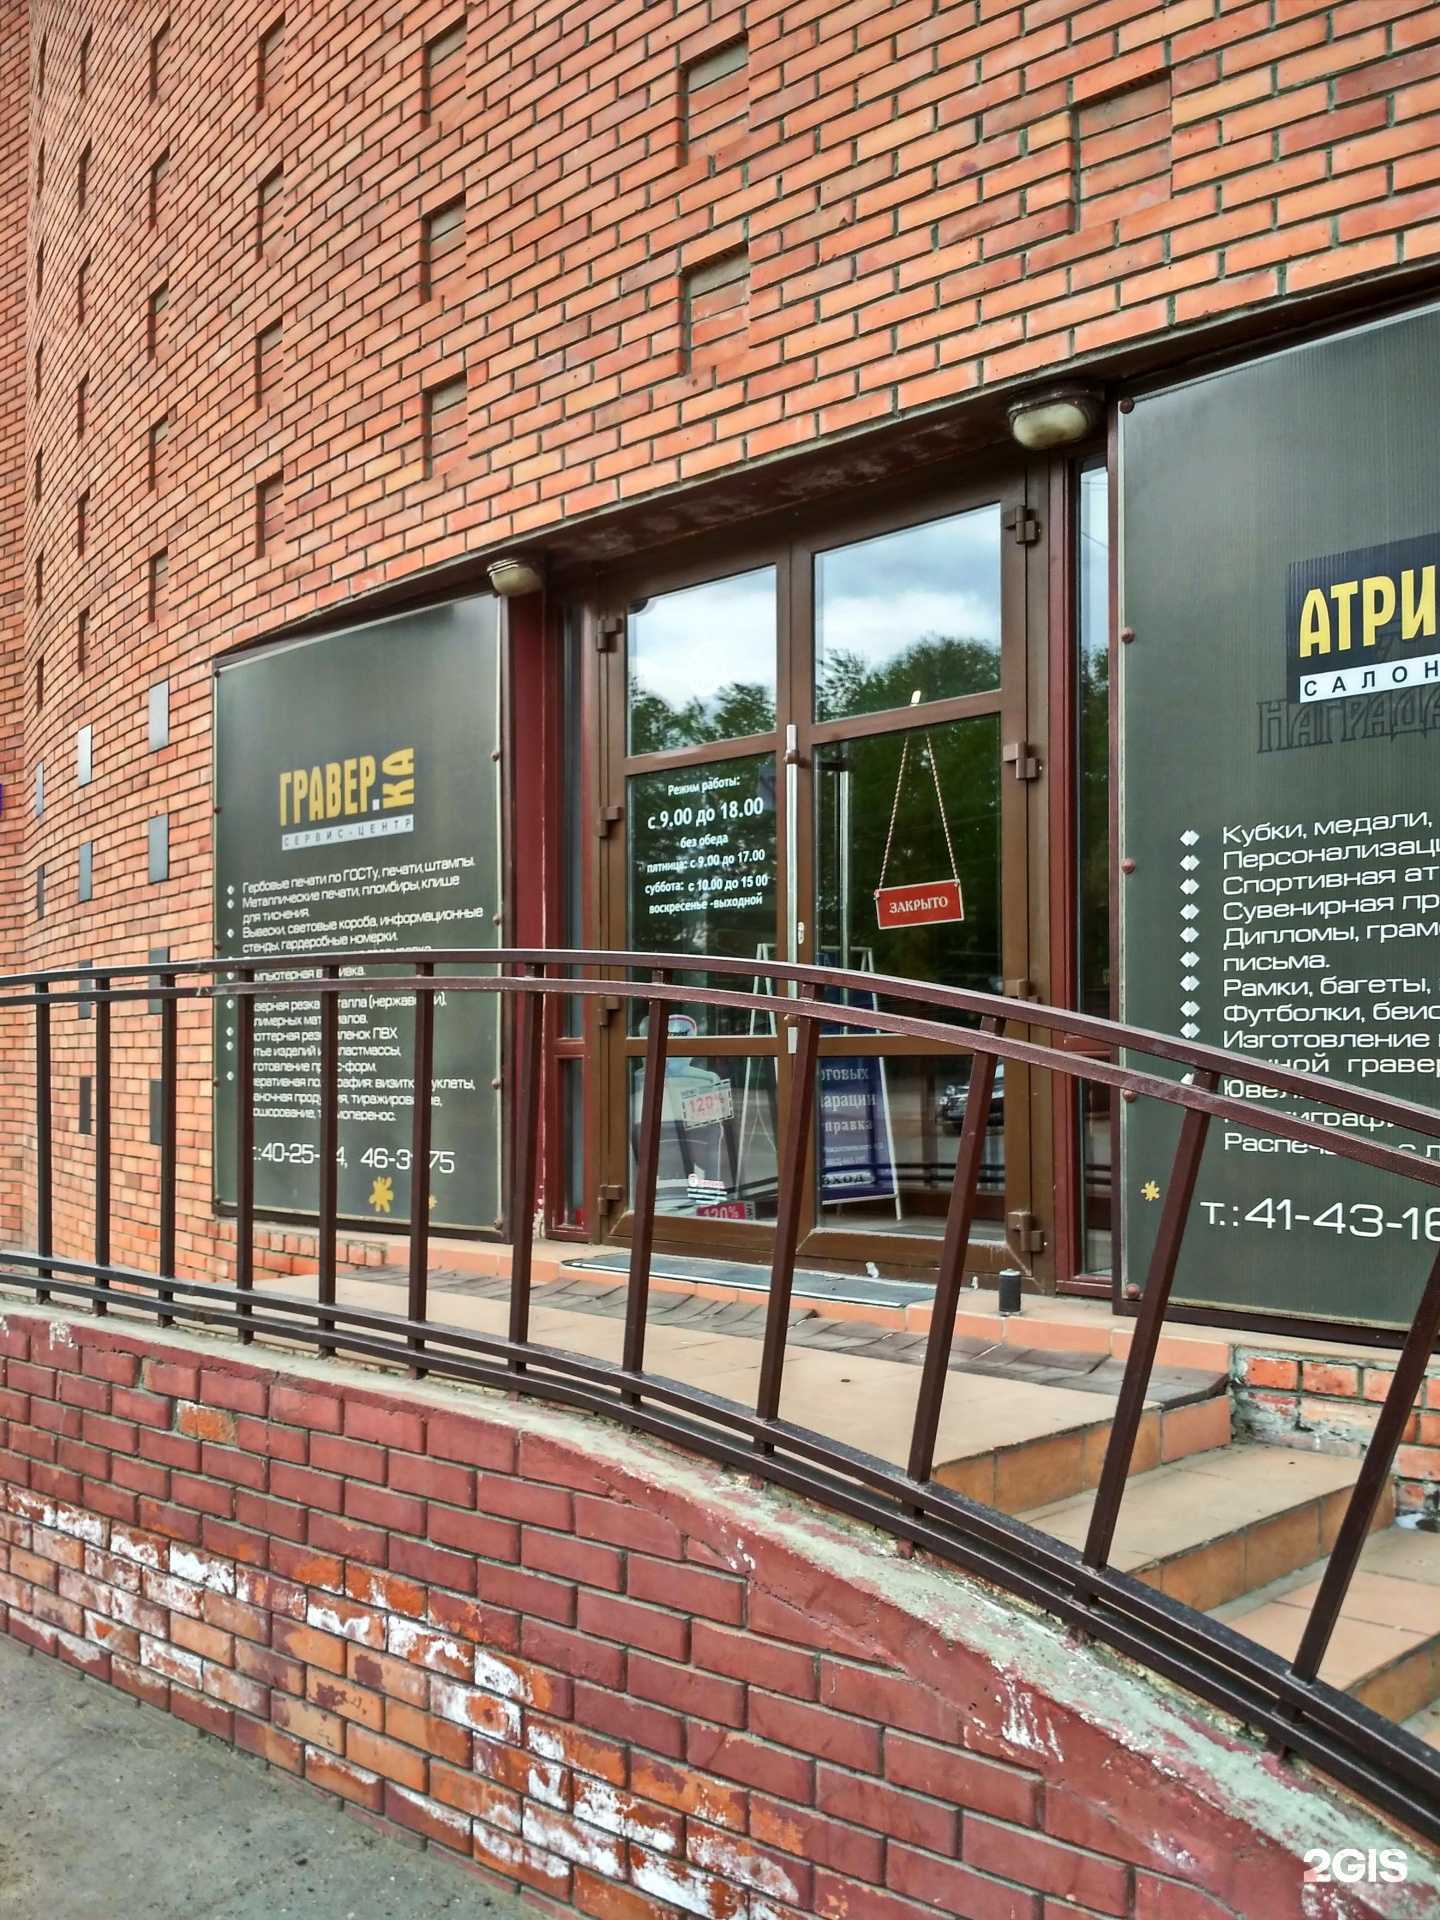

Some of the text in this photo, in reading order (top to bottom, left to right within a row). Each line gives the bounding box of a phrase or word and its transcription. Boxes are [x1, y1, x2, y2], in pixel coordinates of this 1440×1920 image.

[1299, 564, 1437, 658] АТРИ
[1304, 660, 1439, 696] САЛОН
[668, 776, 741, 796] Режим работы:
[648, 797, 764, 829] с 9.00 до 18.00
[284, 818, 411, 848] СЕРВИС-ЦЕНТР
[1223, 812, 1433, 847] Кубки, медали,
[680, 834, 729, 849] без обеда
[647, 849, 766, 874] пятница: с 9.00 до 17.00
[243, 879, 290, 895] Гербовые
[291, 875, 327, 889] печати
[328, 872, 342, 884] по
[421, 875, 460, 889] клише
[645, 880, 685, 896] суббота:
[688, 882, 695, 892] с
[697, 878, 724, 892] 10.00
[724, 877, 739, 892] до
[1223, 868, 1396, 896] Спортивная
[649, 900, 708, 915] воскресенье
[889, 895, 949, 914] ЗАКРЫТО
[1223, 896, 1394, 925] Сувенирная
[243, 913, 261, 925] для
[380, 906, 484, 927] информационные
[1223, 921, 1440, 950] Дипломы, грам
[1223, 954, 1331, 971] письма.
[1223, 976, 1432, 998] Рамки, багеты,
[1223, 1003, 1365, 1027] Футболки,
[372, 1026, 398, 1040] ПВХ
[1223, 1030, 1430, 1049] Изготовление
[254, 1062, 309, 1073] готовление
